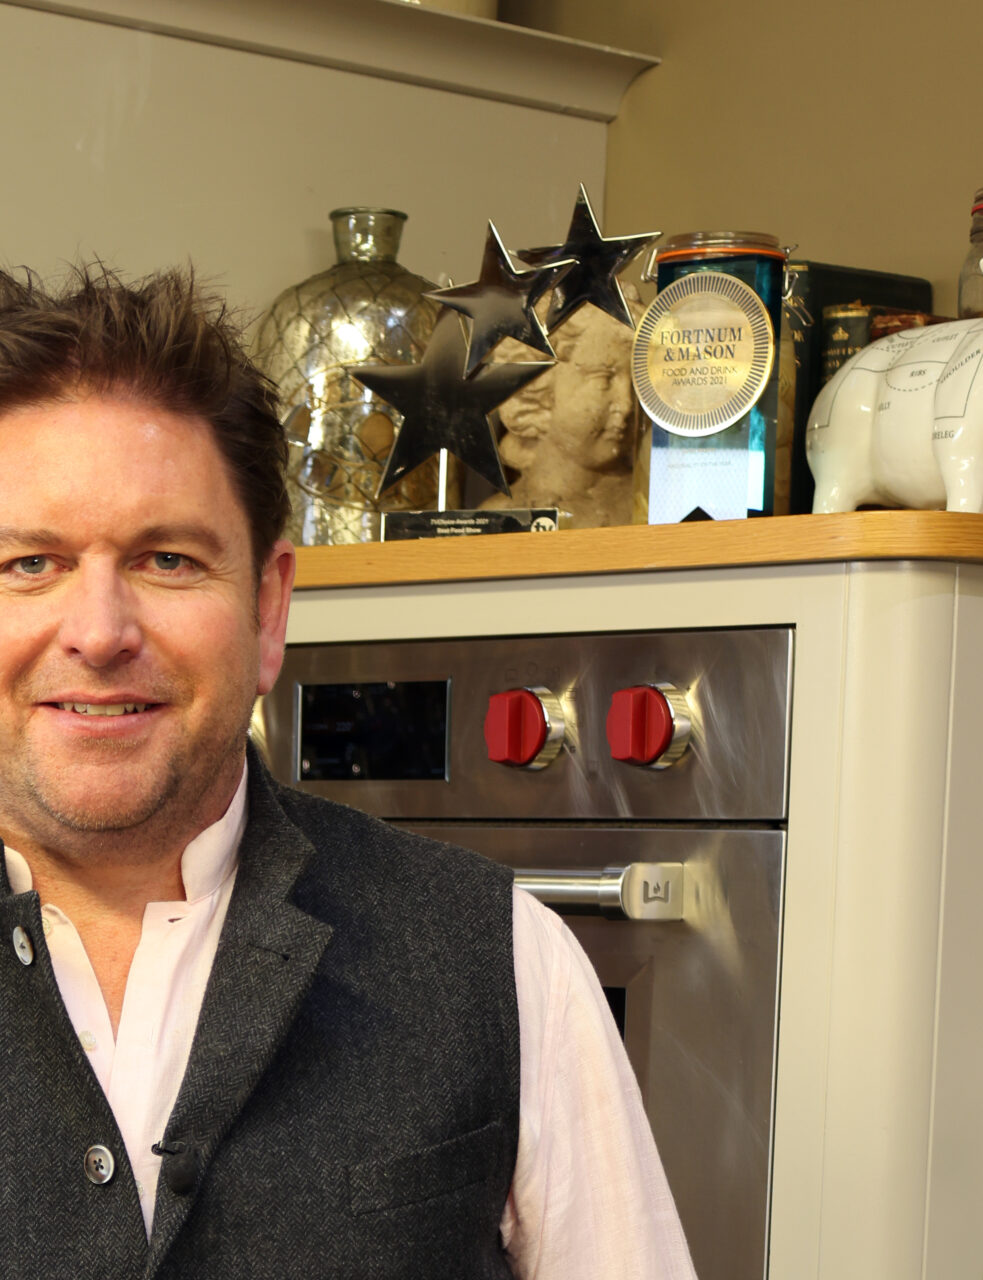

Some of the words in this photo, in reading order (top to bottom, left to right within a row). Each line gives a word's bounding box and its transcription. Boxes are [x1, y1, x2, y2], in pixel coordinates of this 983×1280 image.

[660, 327, 743, 345] FORTNUM
[663, 347, 675, 362] &
[677, 344, 737, 361] MASON
[662, 368, 687, 376] FOOD
[690, 367, 709, 375] AND
[710, 366, 737, 375] DRINK
[671, 377, 708, 386] AWARDS
[710, 376, 727, 385] 2021
